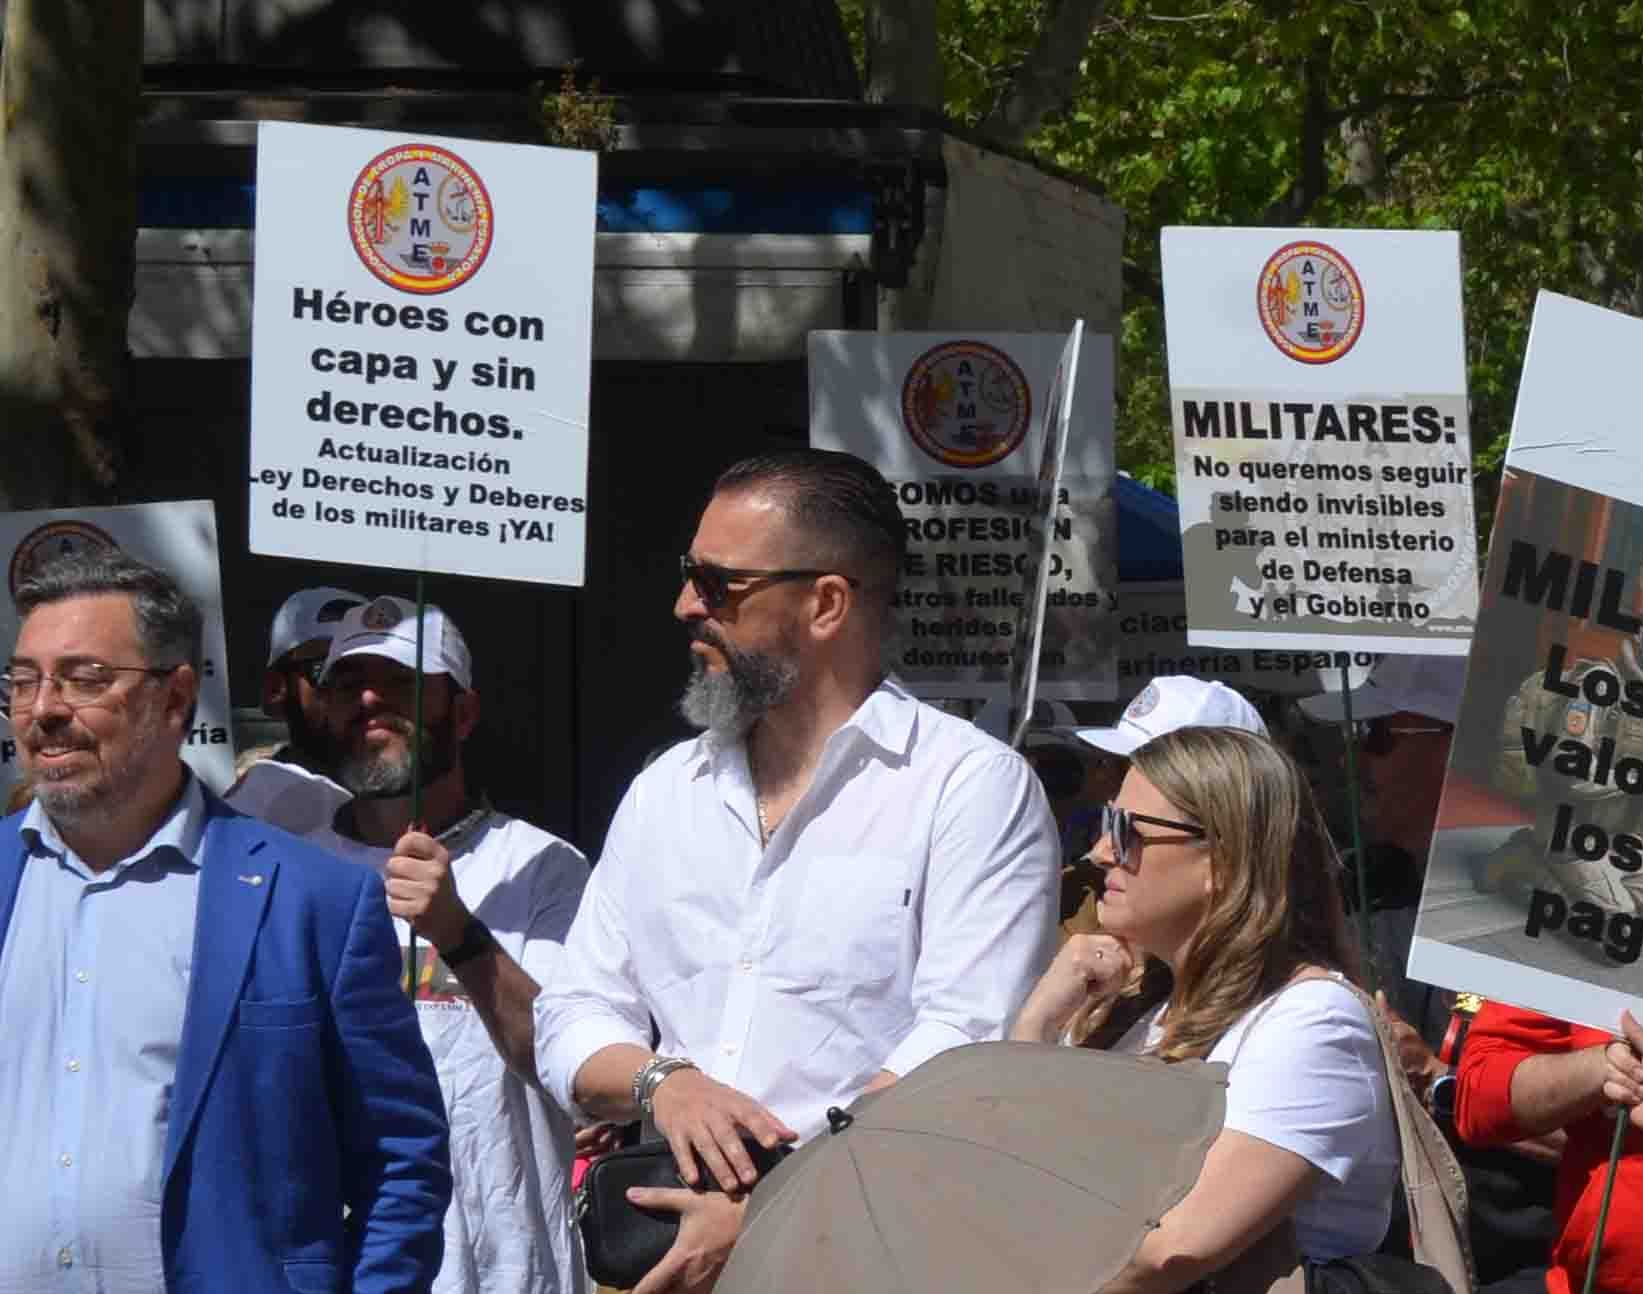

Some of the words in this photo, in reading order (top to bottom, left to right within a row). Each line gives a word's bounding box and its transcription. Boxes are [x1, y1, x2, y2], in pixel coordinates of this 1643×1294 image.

[293, 286, 449, 331] Héroes
[465, 310, 543, 340] con
[311, 347, 417, 383] capa
[432, 357, 457, 390] y
[472, 356, 535, 391] sin
[306, 391, 522, 440] derechos.
[1184, 401, 1457, 444] MILITARES:
[318, 438, 510, 474] Actualización
[1194, 456, 1229, 477] No
[1239, 462, 1373, 482] queremos
[1381, 461, 1467, 488] seguir
[302, 468, 434, 499] Derechos
[444, 484, 460, 506] y
[469, 483, 585, 513] Deberes
[1219, 491, 1309, 514] siendo
[1317, 493, 1445, 518] invisibles
[272, 498, 305, 519] de
[315, 501, 355, 524] los
[365, 508, 490, 537] militares
[499, 518, 554, 543] ¡YA!
[1215, 527, 1275, 551] para
[1286, 527, 1308, 547] el
[1317, 526, 1455, 552] ministerio
[1261, 558, 1294, 580] de
[1303, 560, 1412, 585] Defensa
[1249, 597, 1265, 620] y
[1273, 592, 1297, 615] el
[1306, 594, 1430, 619] Gobierno
[1550, 804, 1643, 874] los
